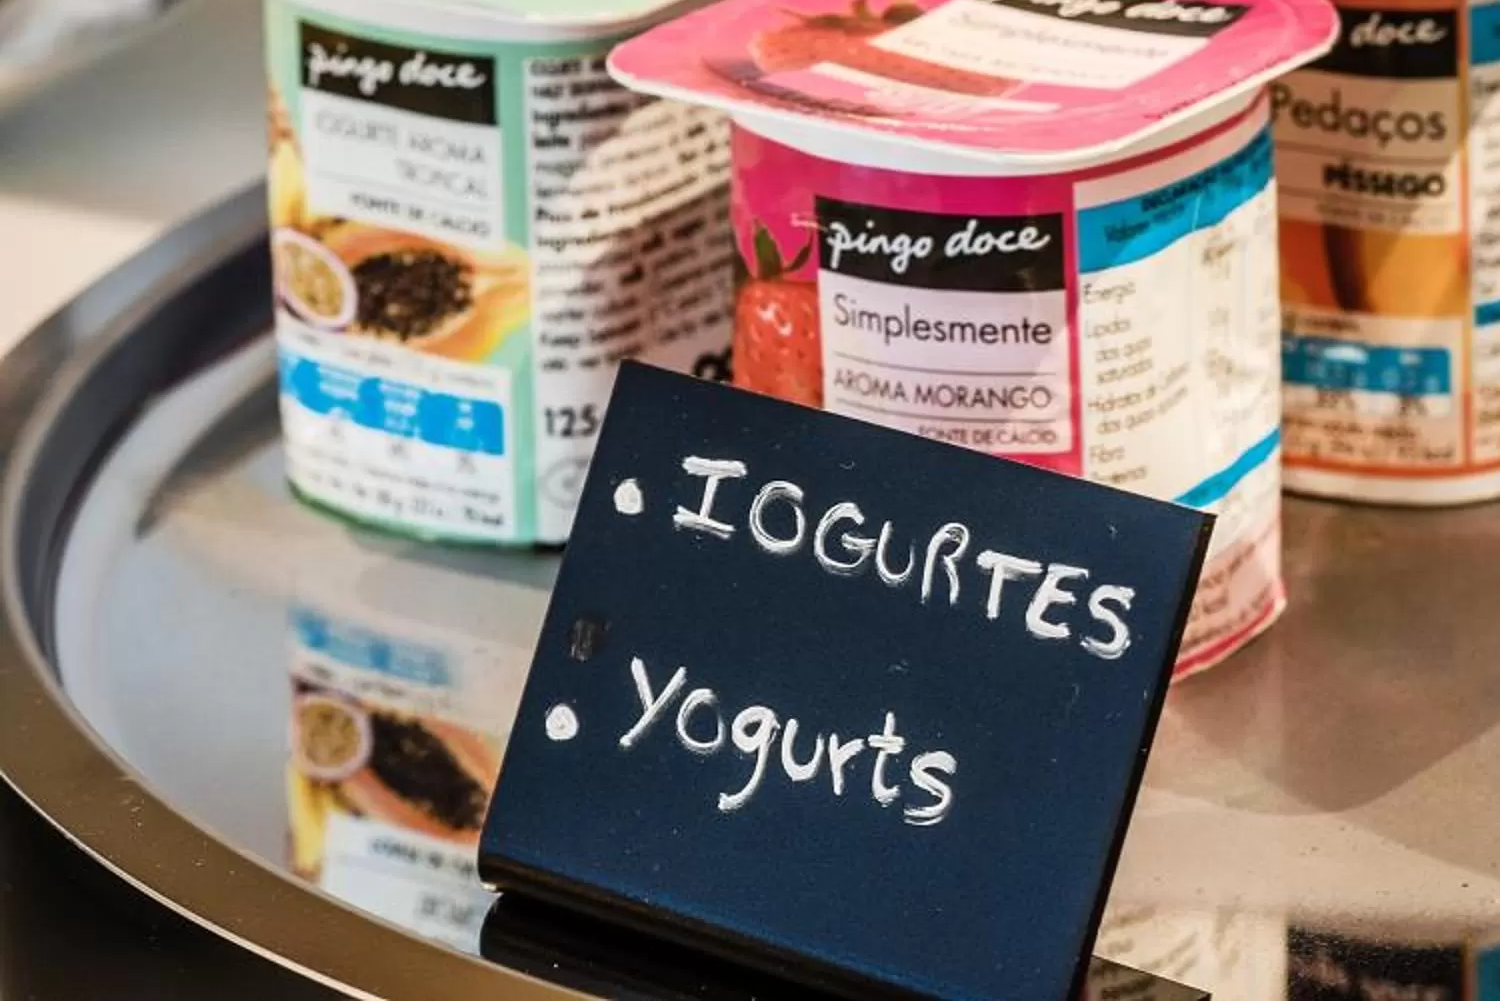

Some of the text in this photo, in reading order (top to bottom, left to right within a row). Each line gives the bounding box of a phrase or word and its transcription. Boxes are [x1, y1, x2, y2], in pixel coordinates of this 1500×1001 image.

[1350, 12, 1448, 48] doce
[307, 42, 394, 96] pingo
[398, 50, 487, 89] doce
[1269, 83, 1447, 146] Pedaços
[1323, 160, 1446, 198] PÉSSEGO
[826, 219, 931, 273] pingo
[943, 219, 1050, 257] doce
[832, 293, 1052, 346] Simplesmente
[833, 373, 1052, 409] AROMA MORANGO
[543, 402, 599, 439] 125
[972, 429, 993, 445] DE
[673, 455, 1136, 660] IOGURTES
[619, 656, 958, 826] Yogurts
